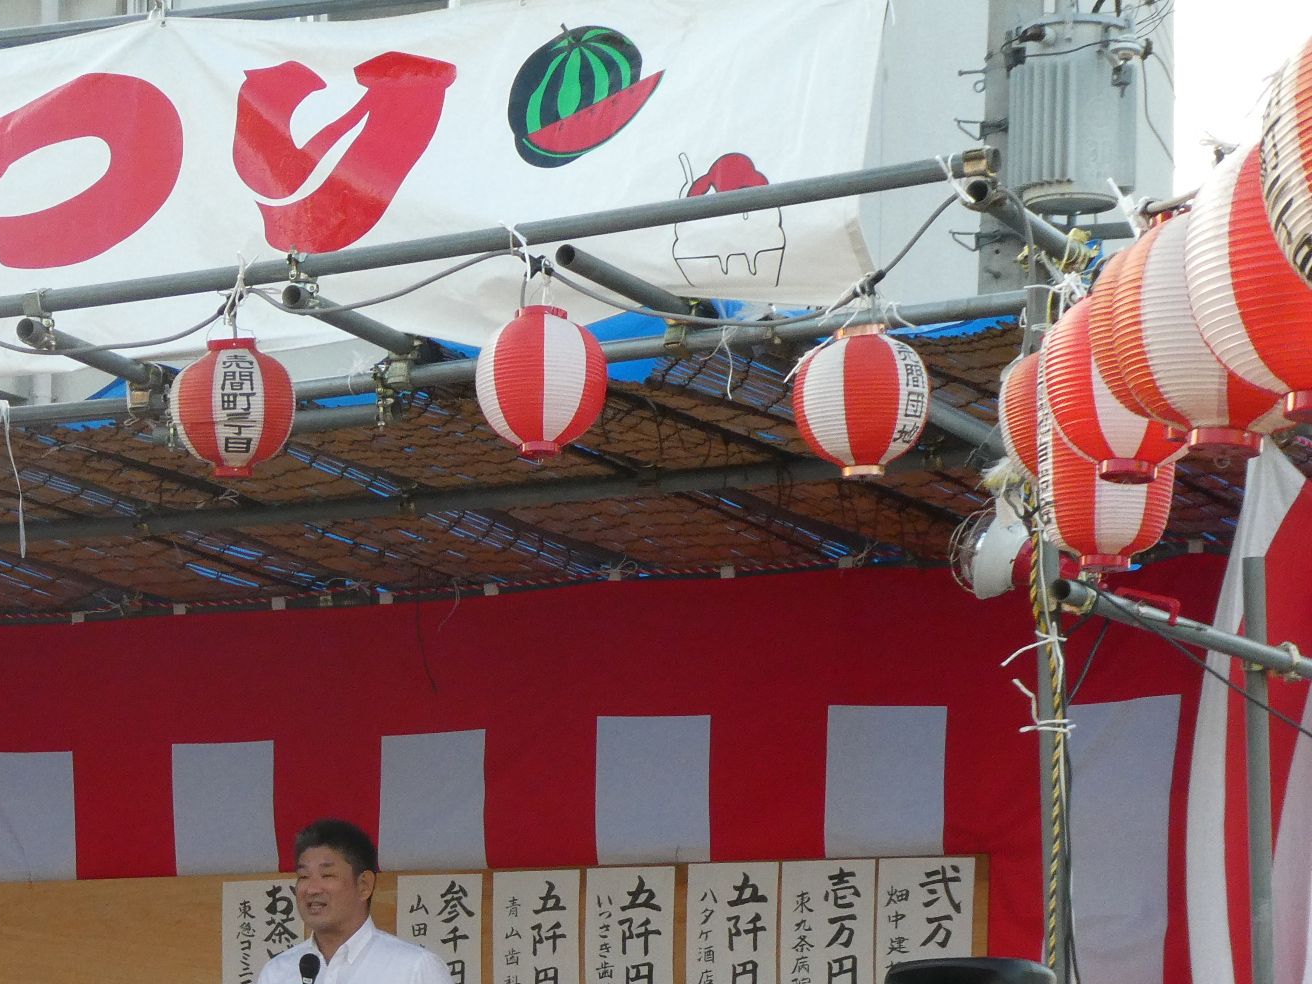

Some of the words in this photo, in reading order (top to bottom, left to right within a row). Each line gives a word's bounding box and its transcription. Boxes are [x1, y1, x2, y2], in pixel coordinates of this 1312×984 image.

[408, 894, 430, 951] 山田
[884, 885, 912, 969] 畑中建
